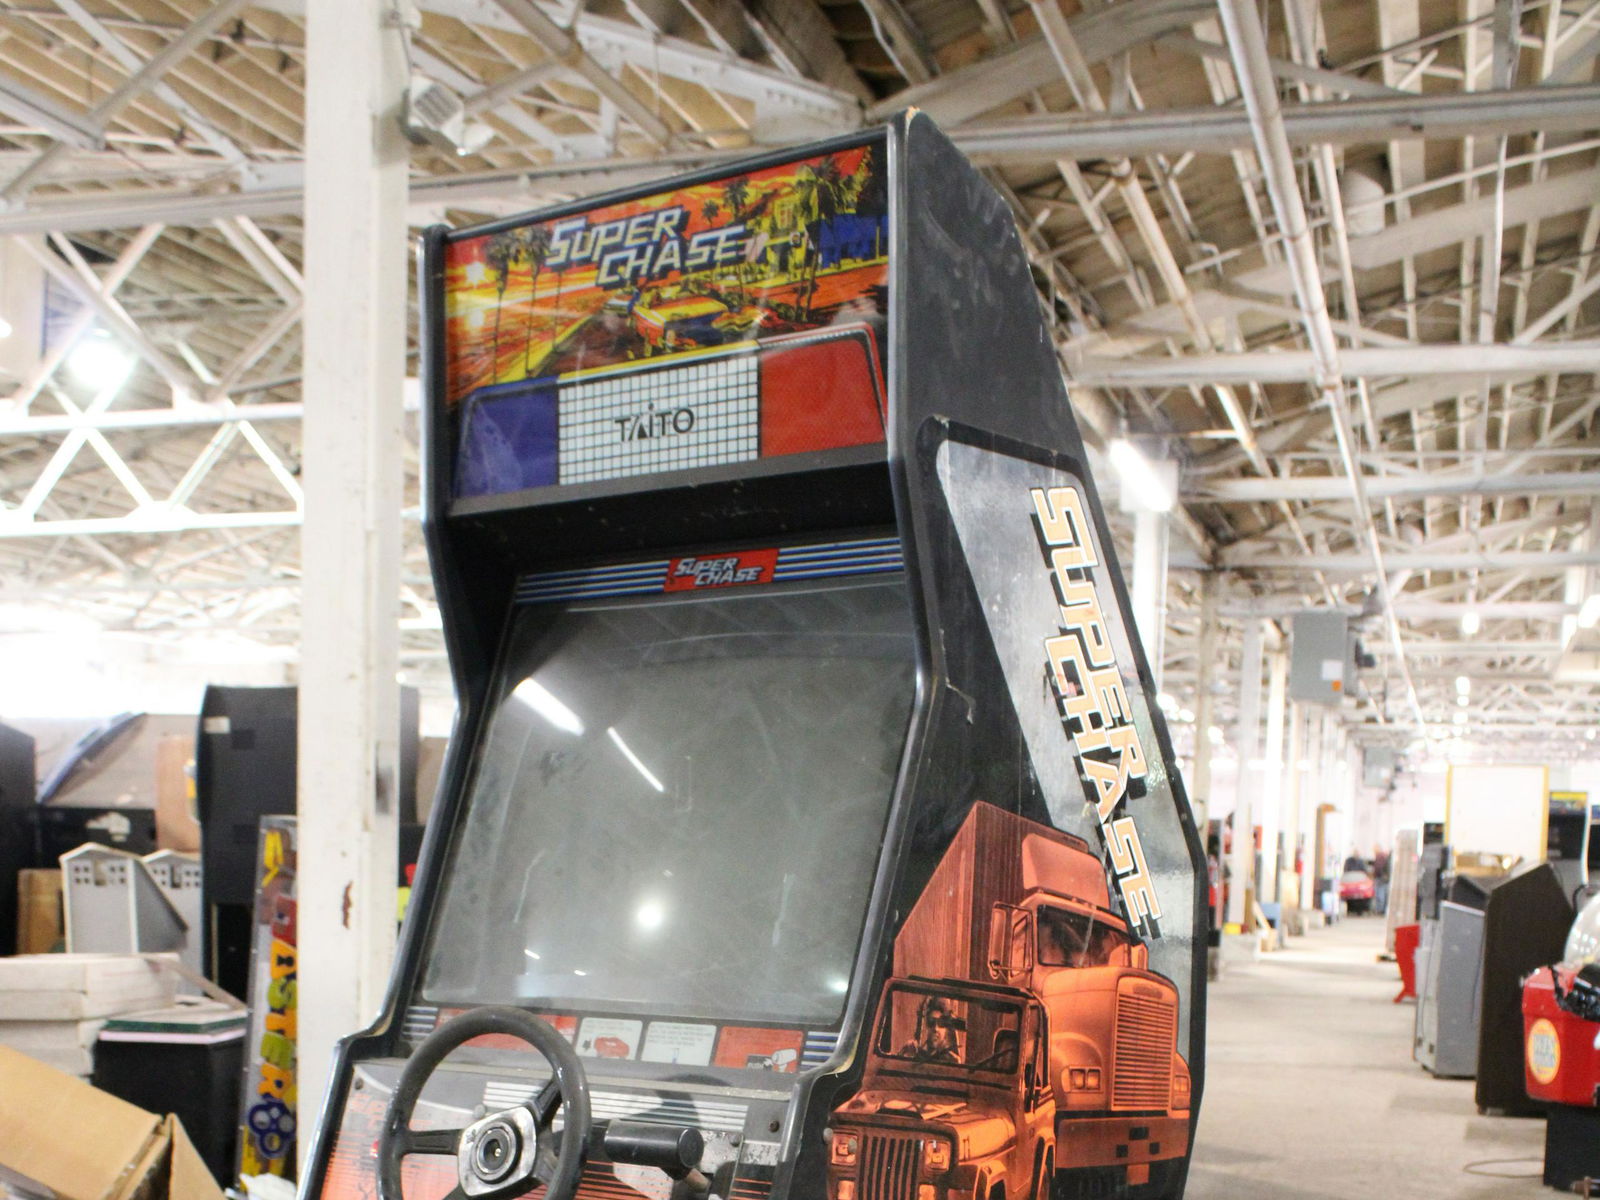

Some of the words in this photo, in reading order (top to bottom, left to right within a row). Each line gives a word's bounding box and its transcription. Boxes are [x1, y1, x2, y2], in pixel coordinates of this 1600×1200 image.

[545, 206, 688, 266] SUPER
[598, 225, 746, 285] CHASE
[674, 557, 739, 577] SUPER
[694, 566, 763, 586] CHASE
[1031, 487, 1148, 780] SUPER
[1044, 634, 1162, 928] CHASE
